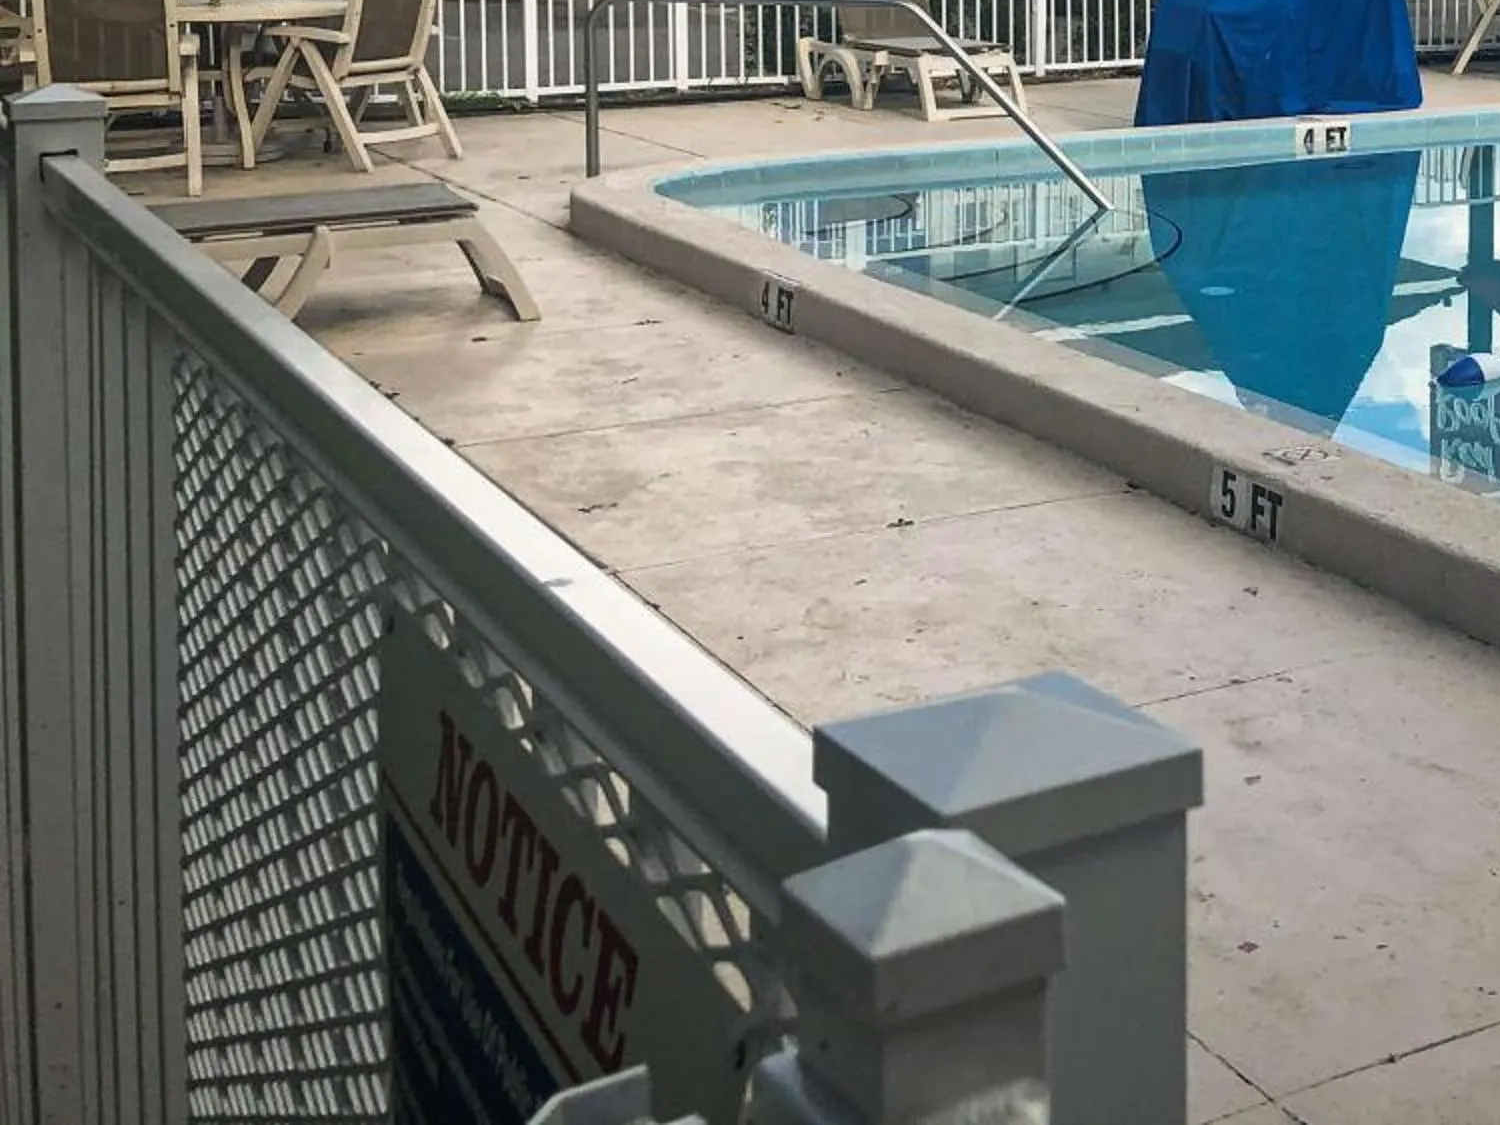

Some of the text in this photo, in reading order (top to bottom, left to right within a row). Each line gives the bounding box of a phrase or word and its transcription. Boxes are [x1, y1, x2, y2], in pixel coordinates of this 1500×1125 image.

[761, 281, 795, 325] 4 FT
[1221, 469, 1284, 541] 5 FT
[429, 708, 640, 1074] NOTICE
